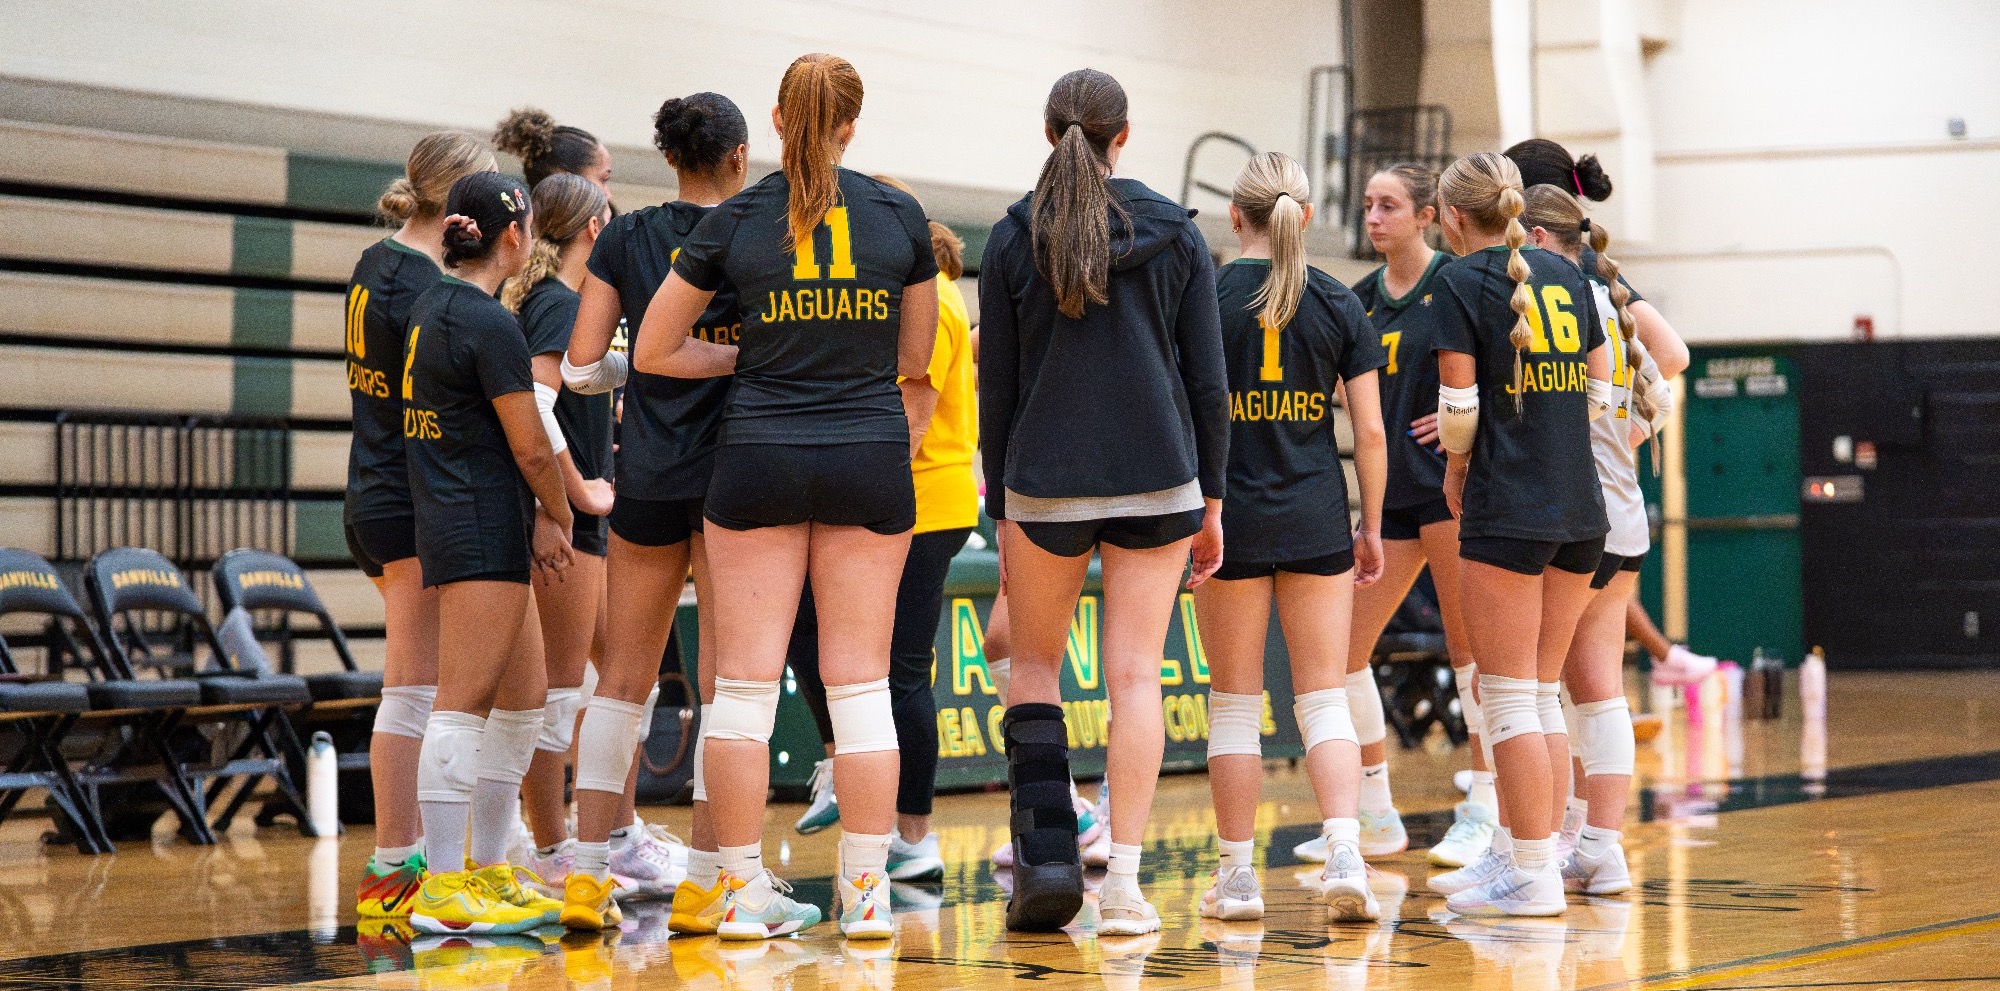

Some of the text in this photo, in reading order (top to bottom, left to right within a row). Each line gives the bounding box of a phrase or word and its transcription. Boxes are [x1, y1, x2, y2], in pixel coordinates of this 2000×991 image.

[792, 206, 858, 281] 11
[346, 283, 370, 359] 10
[761, 287, 890, 324] JAGUARS
[1522, 282, 1582, 354] 16
[1258, 315, 1284, 382] 1
[1381, 330, 1402, 375] 7
[1505, 361, 1587, 394] AGUAR
